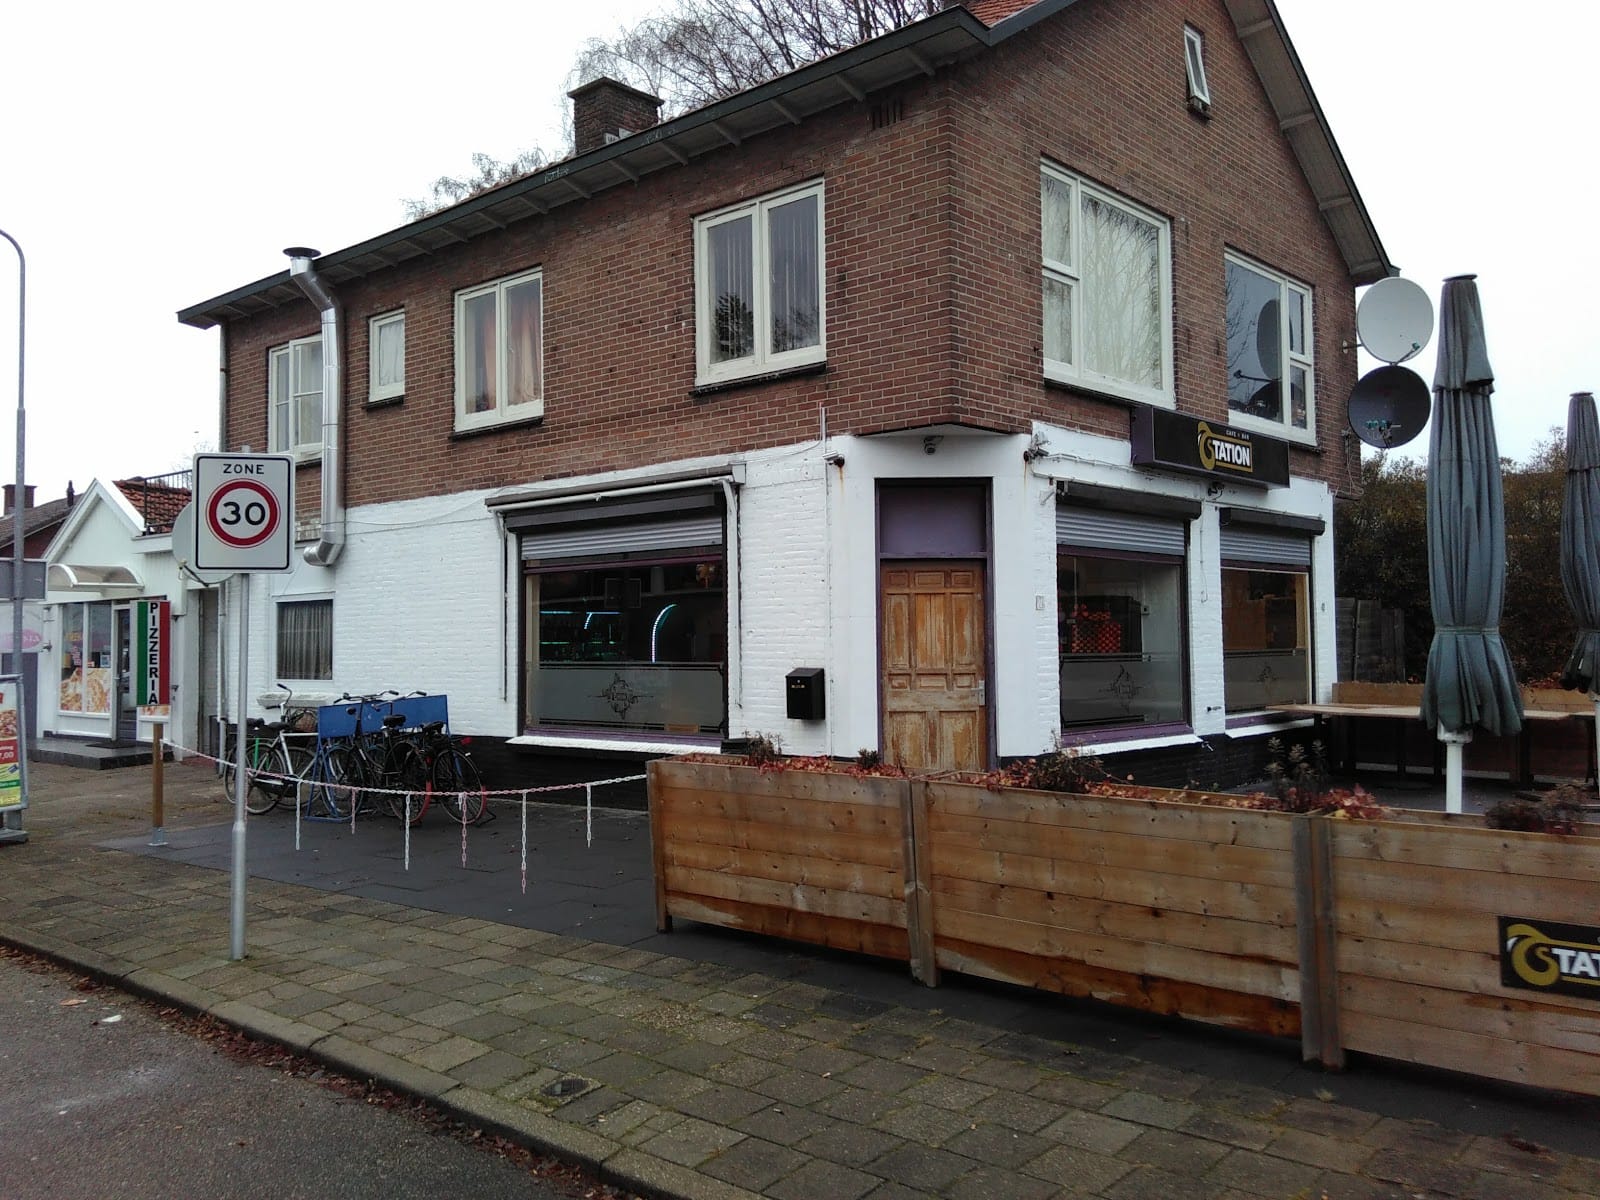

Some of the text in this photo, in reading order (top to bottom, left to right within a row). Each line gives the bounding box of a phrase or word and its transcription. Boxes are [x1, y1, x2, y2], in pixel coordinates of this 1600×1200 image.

[1199, 428, 1251, 470] STATION
[223, 463, 265, 475] ZONE
[221, 501, 266, 526] 30
[148, 602, 159, 706] PIZZERIA
